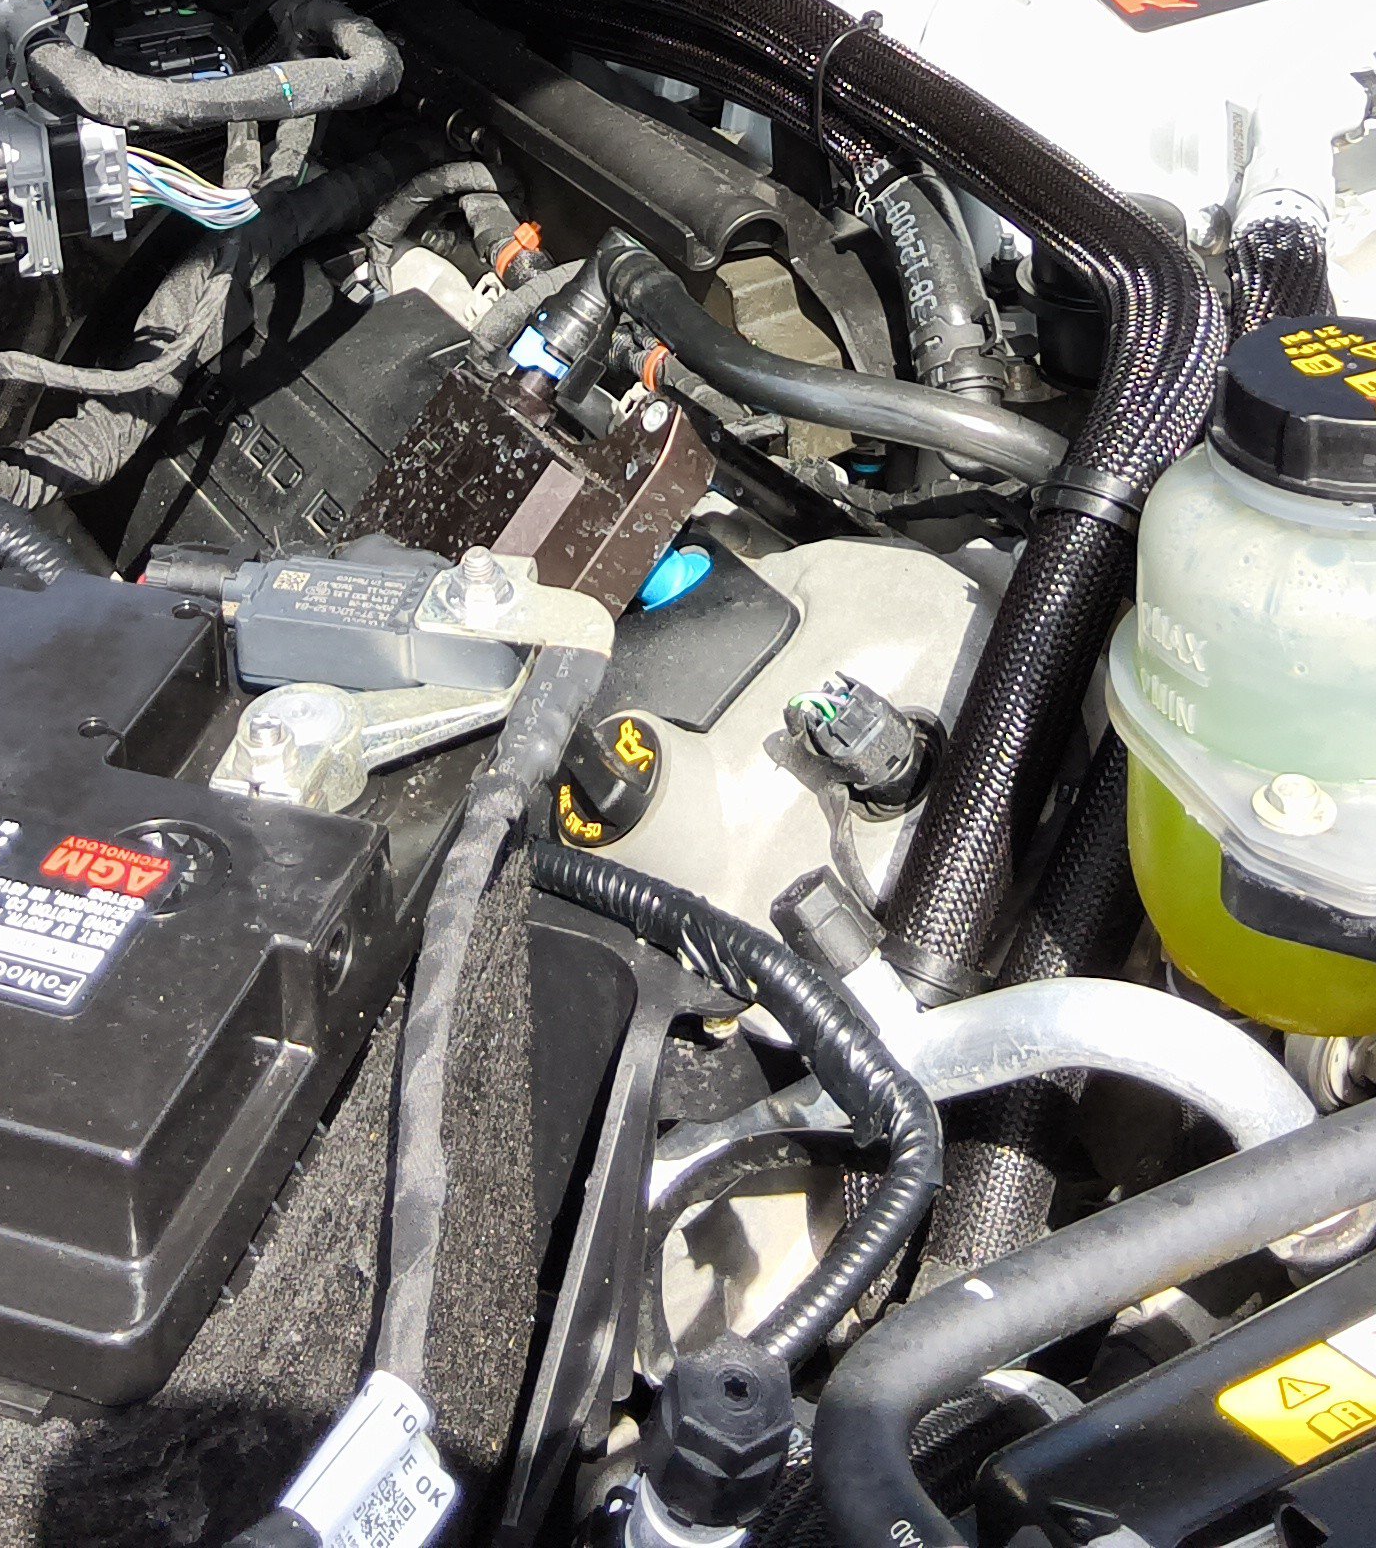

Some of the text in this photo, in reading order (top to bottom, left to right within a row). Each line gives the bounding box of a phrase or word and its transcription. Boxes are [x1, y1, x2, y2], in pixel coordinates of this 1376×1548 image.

[46, 850, 160, 890] AGM
[69, 838, 167, 868] TECHNOLOGY
[415, 1474, 448, 1509] OK
